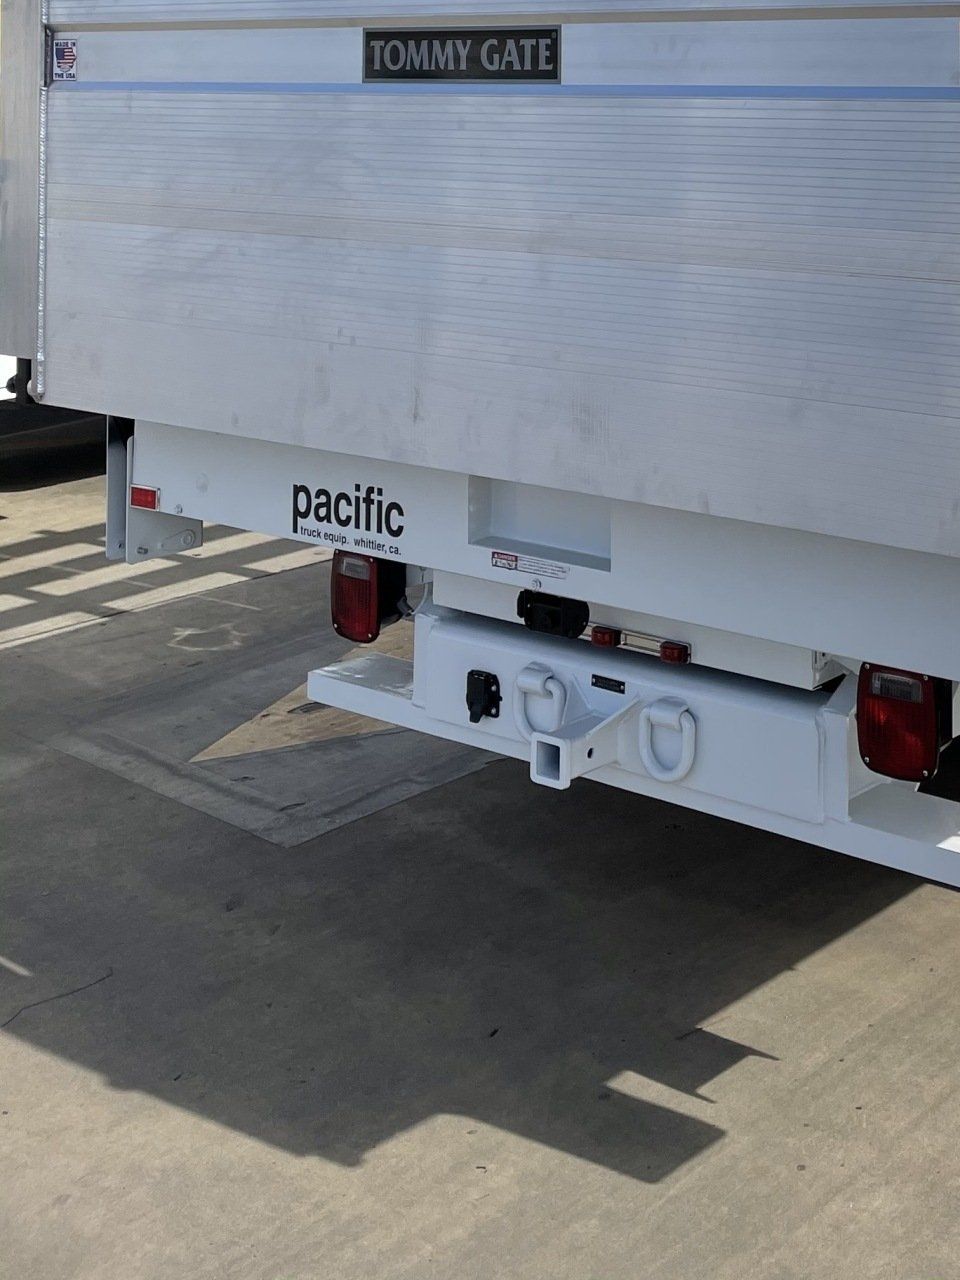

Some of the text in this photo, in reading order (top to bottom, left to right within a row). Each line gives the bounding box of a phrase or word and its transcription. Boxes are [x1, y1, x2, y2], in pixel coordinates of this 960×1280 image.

[370, 38, 554, 71] TOMMY GATE
[292, 483, 405, 538] pacific
[300, 525, 402, 556] truck equip. whittier, ca.
